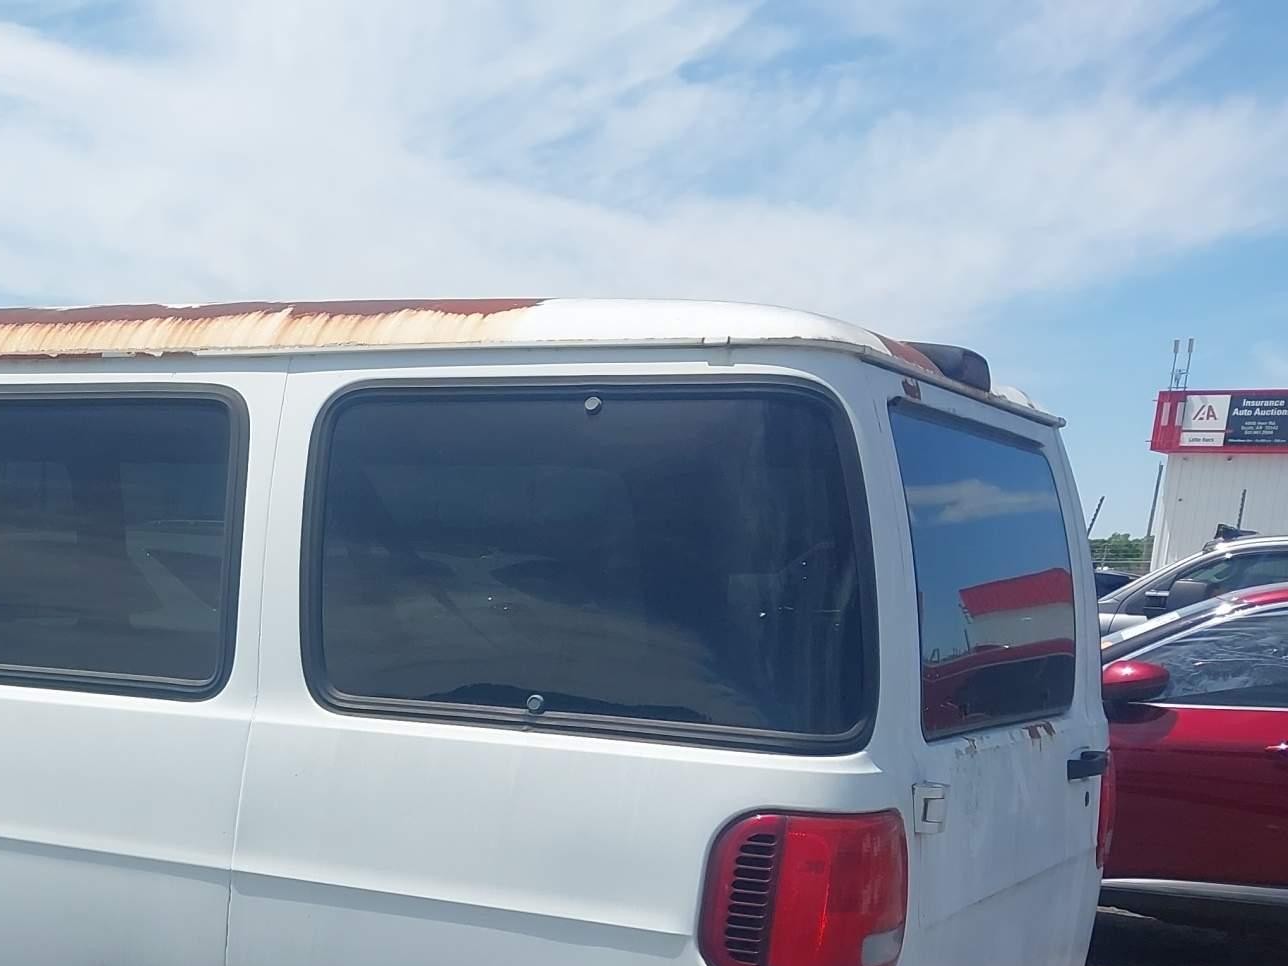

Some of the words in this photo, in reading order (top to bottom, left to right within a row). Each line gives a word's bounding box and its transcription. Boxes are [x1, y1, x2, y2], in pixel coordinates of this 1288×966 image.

[1242, 398, 1286, 407] Insurance
[1232, 407, 1253, 416] Auto
[1253, 407, 1288, 416] Auction
